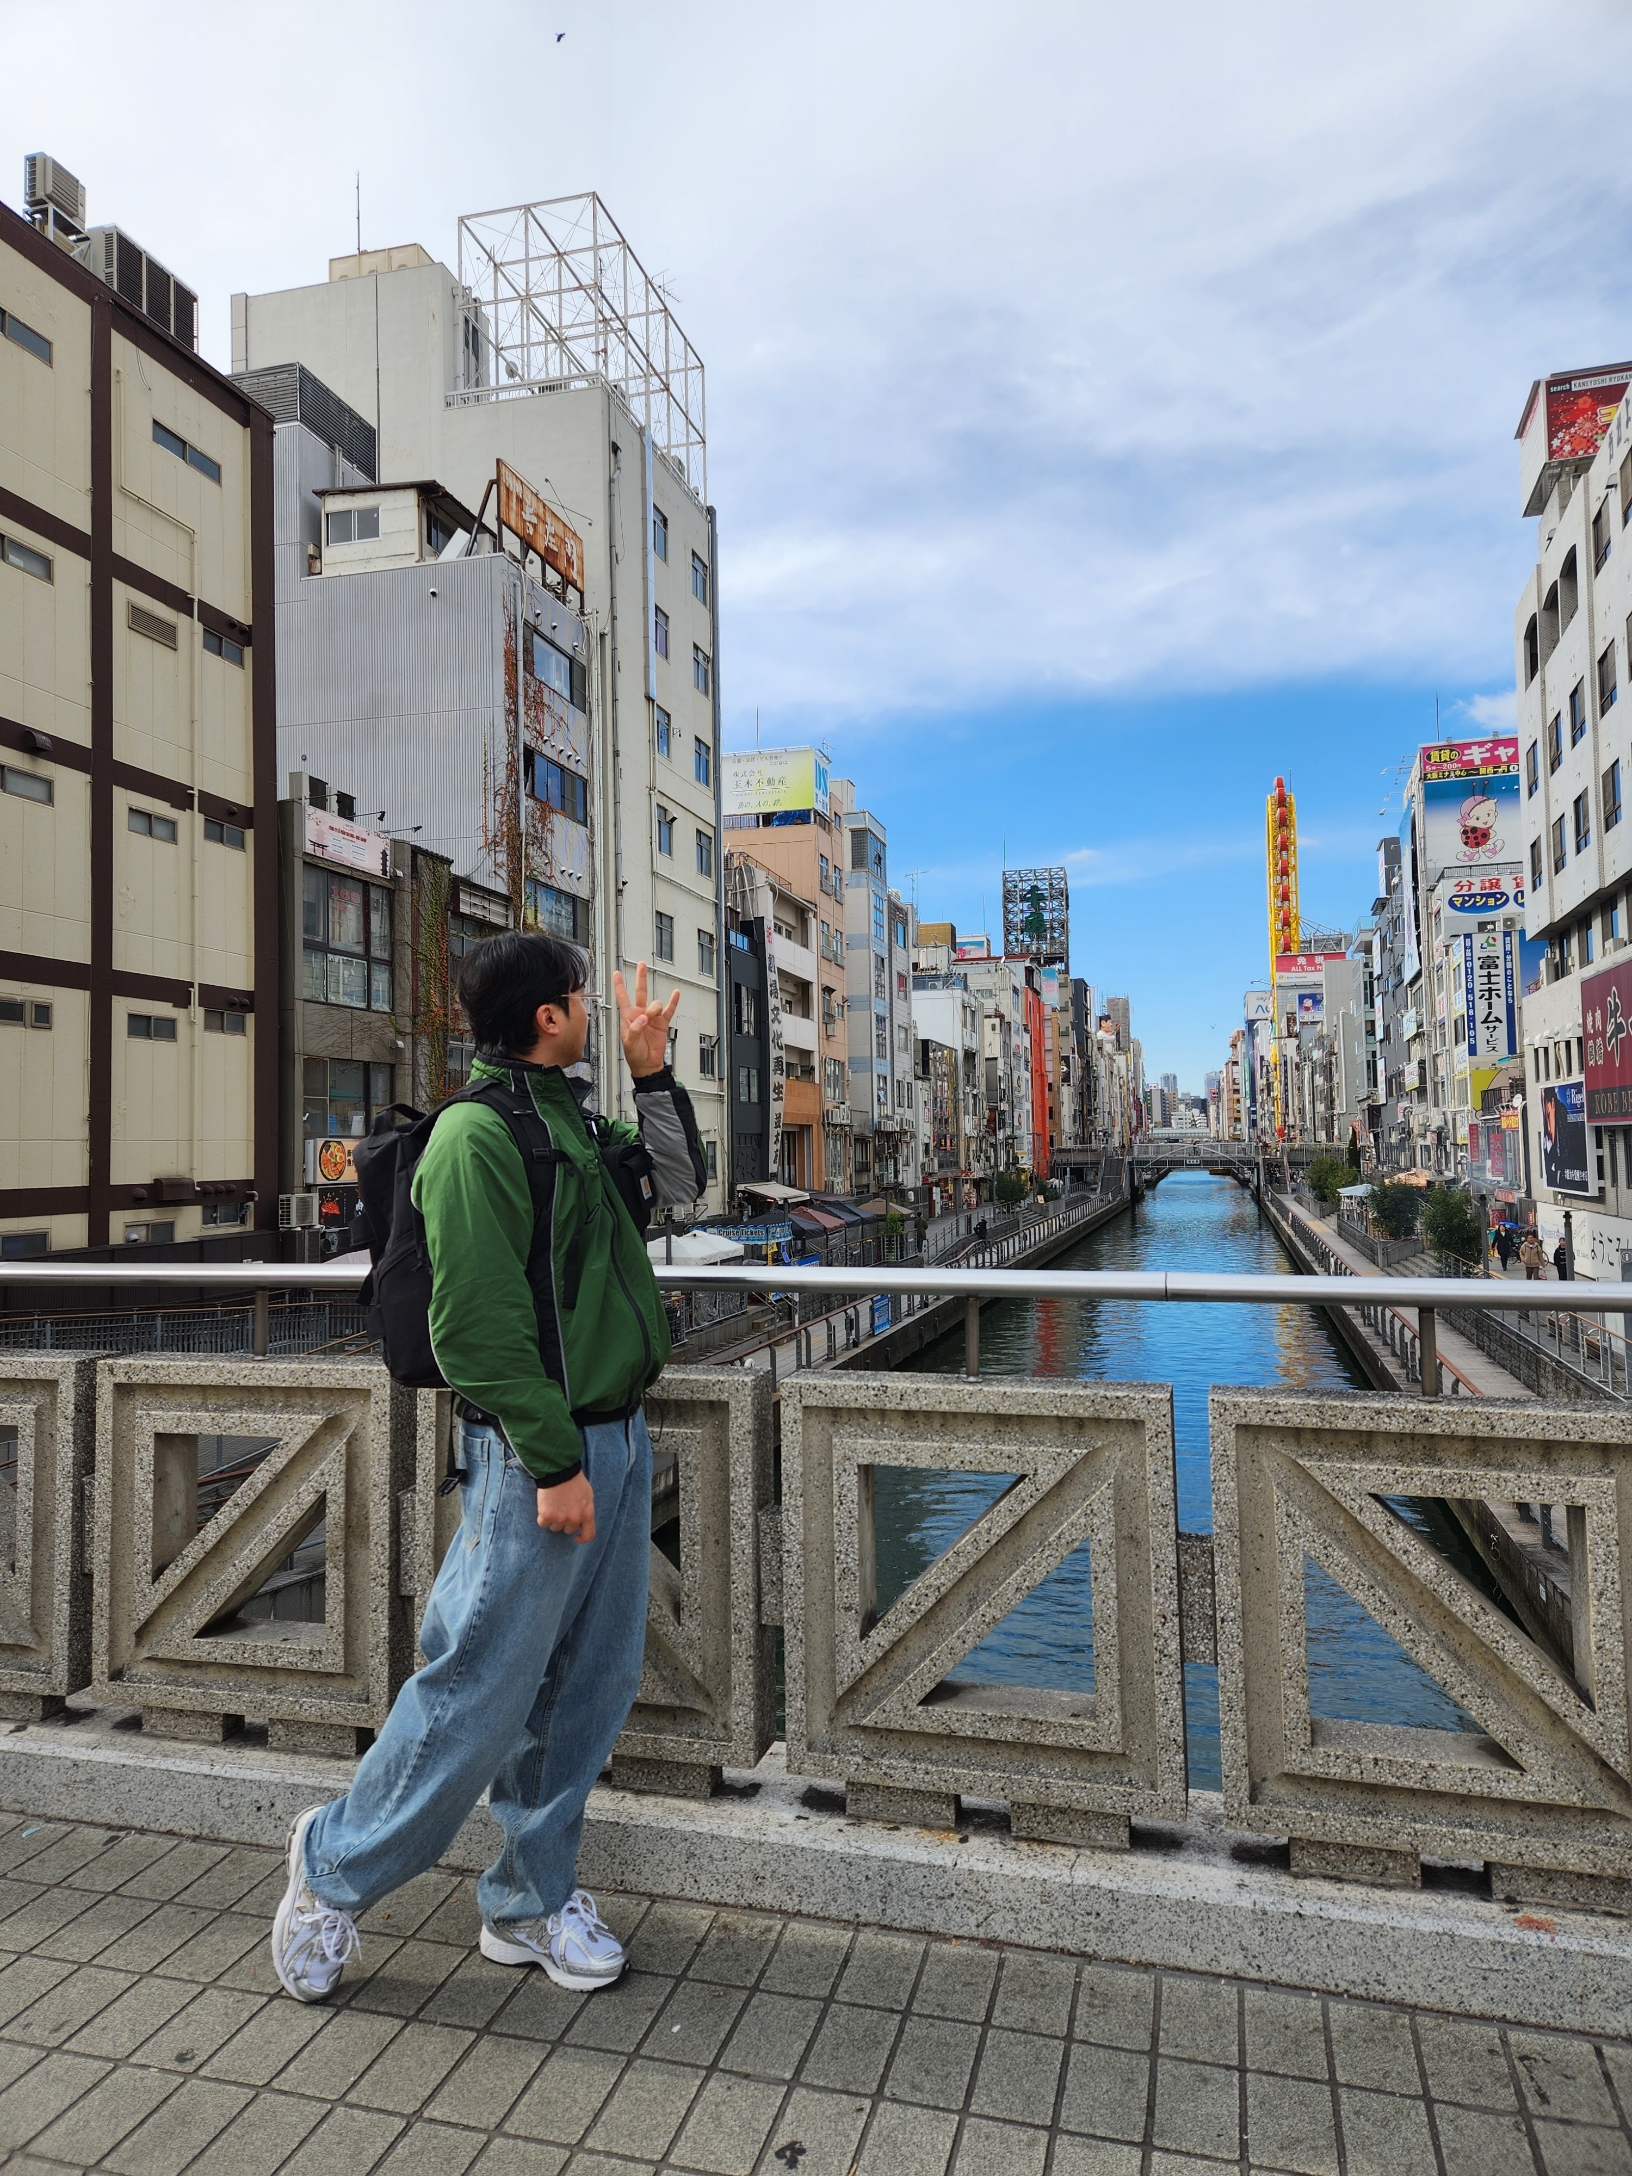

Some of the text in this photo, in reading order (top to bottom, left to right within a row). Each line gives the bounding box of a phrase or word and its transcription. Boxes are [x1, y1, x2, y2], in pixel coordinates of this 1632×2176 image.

[1549, 383, 1570, 393] search
[1573, 377, 1607, 389] KANEYOSHI
[1430, 748, 1459, 763] 賃貸の
[733, 769, 764, 779] 株式会社
[733, 776, 787, 790] 玉木不動産
[1453, 877, 1502, 893] 分譲
[1452, 893, 1507, 908] マンション
[1296, 955, 1325, 966] 免税
[1477, 955, 1503, 1053] 富士ホームサービス
[1594, 1092, 1618, 1115] KOBE
[718, 1228, 740, 1237] Cruise
[740, 1228, 765, 1237] Tickets
